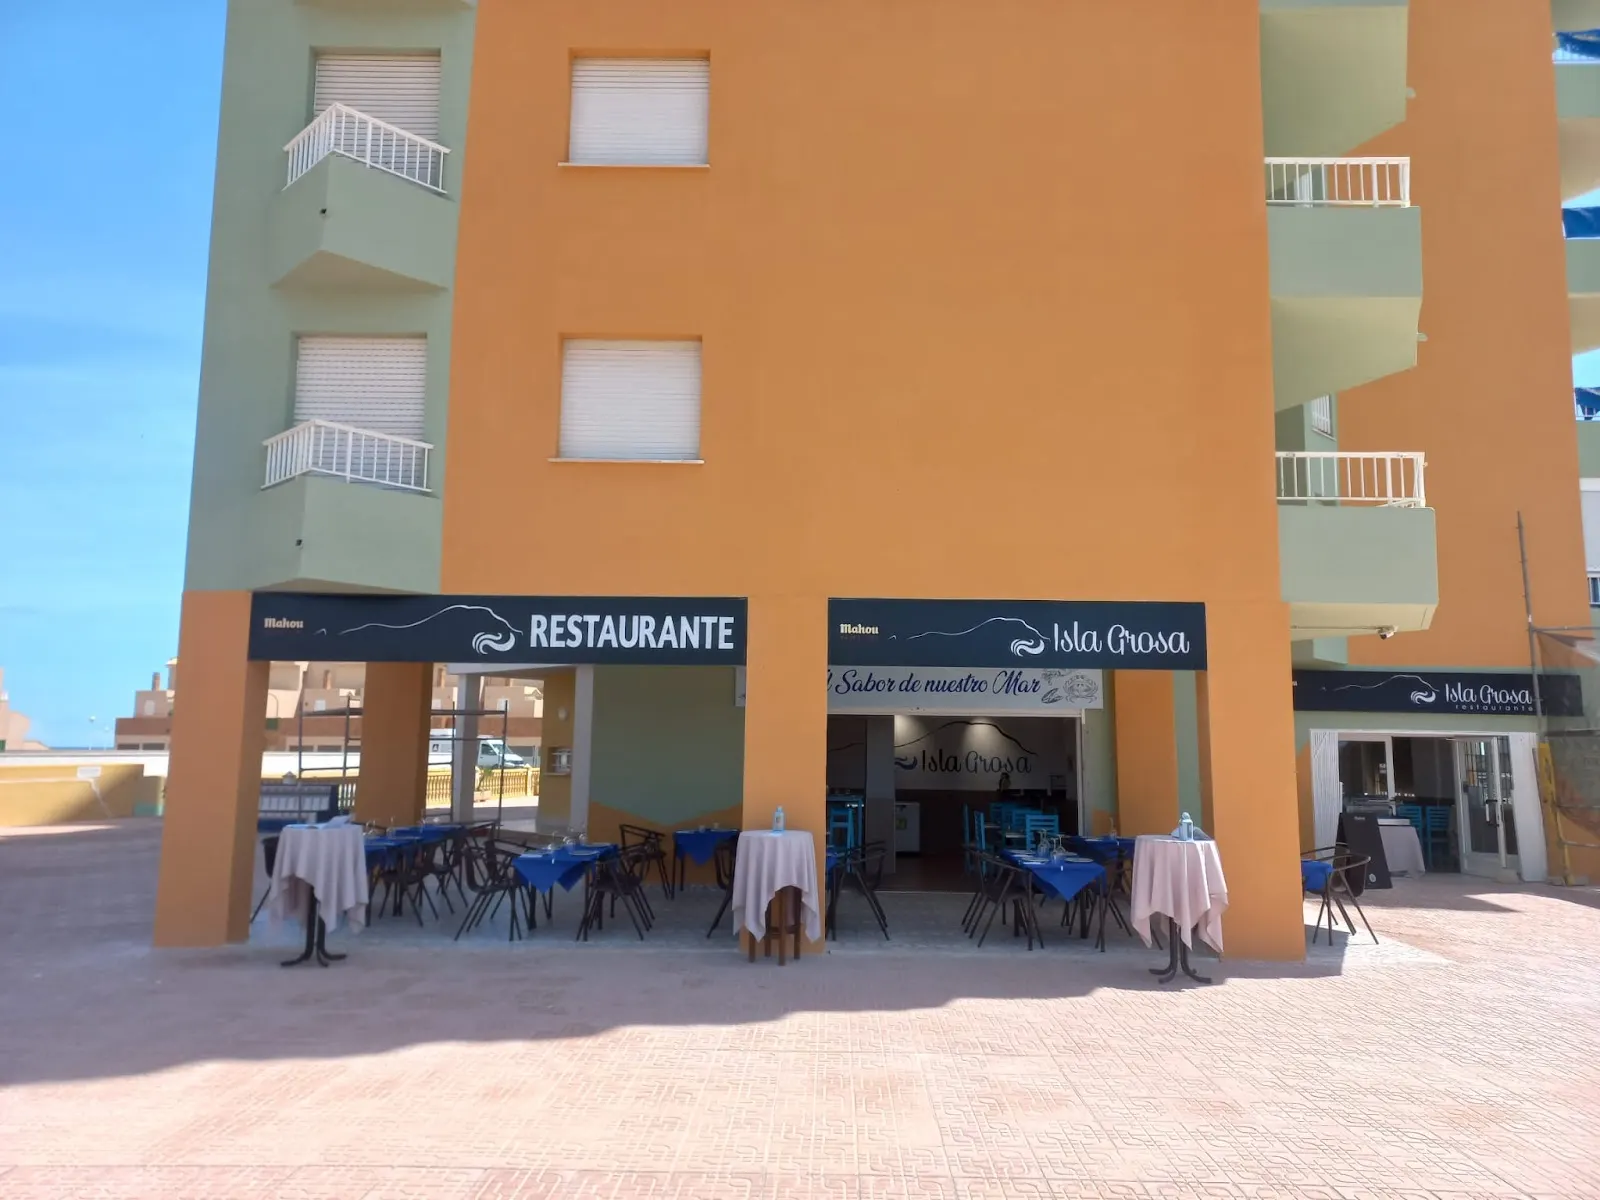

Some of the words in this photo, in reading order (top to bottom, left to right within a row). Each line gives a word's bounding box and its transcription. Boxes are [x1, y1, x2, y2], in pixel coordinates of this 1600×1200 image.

[264, 617, 304, 629] Mahou
[530, 614, 735, 650] RESTAURANTE
[840, 623, 879, 635] Mahou
[1053, 620, 1103, 653] Isla
[1107, 624, 1190, 655] Grosa
[835, 669, 896, 694] Sabor
[898, 673, 922, 693] de
[924, 673, 988, 693] nuestro
[992, 670, 1042, 696] Mar
[1445, 682, 1477, 703] Isla
[1479, 684, 1533, 704] Grosa
[1455, 703, 1534, 712] restaurante
[921, 749, 962, 773] Isla
[965, 750, 1032, 774] Grosa
